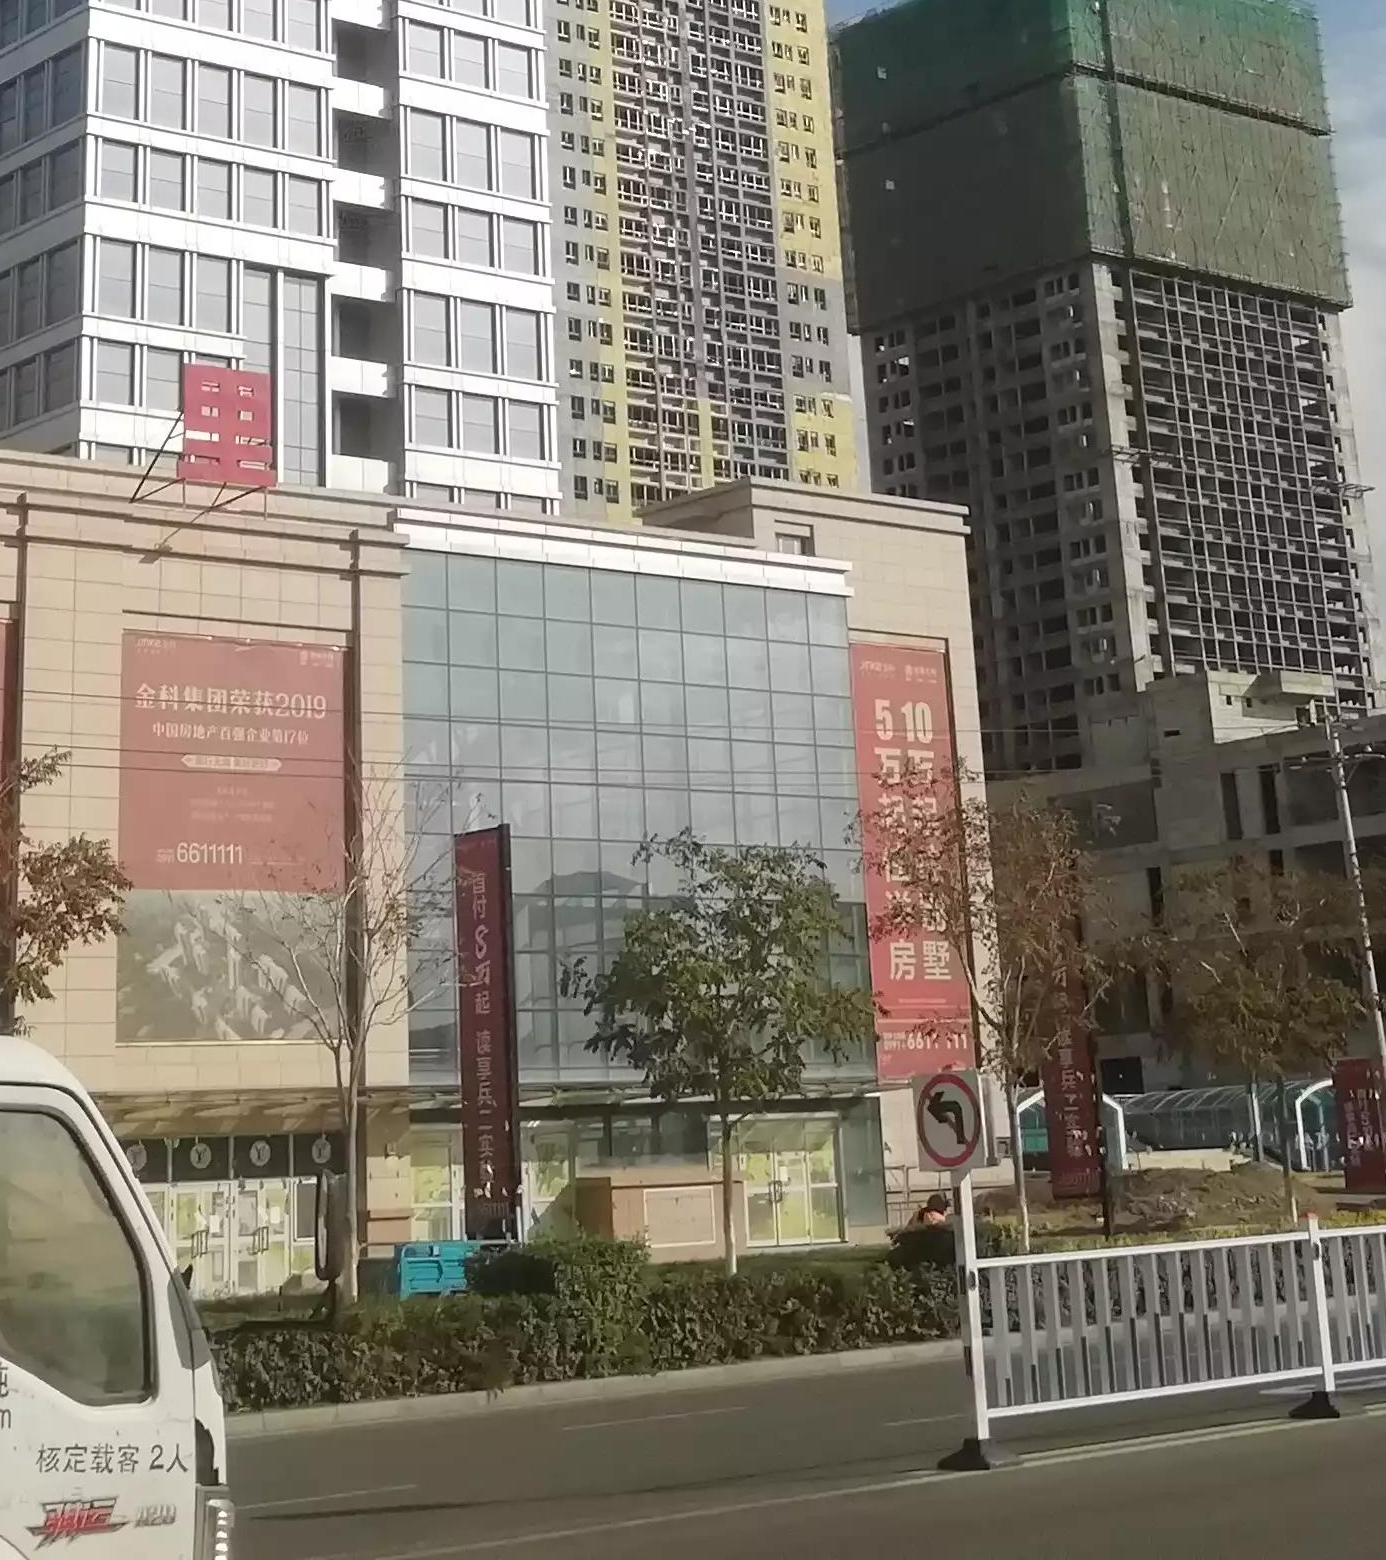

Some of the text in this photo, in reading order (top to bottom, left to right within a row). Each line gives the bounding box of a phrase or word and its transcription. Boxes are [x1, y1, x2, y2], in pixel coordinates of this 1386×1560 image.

[134, 683, 327, 720] 金科集团荣获2019
[176, 842, 244, 865] 6611111
[472, 872, 491, 1014] 首付8万起
[35, 1443, 189, 1474] 核定载客 2人
